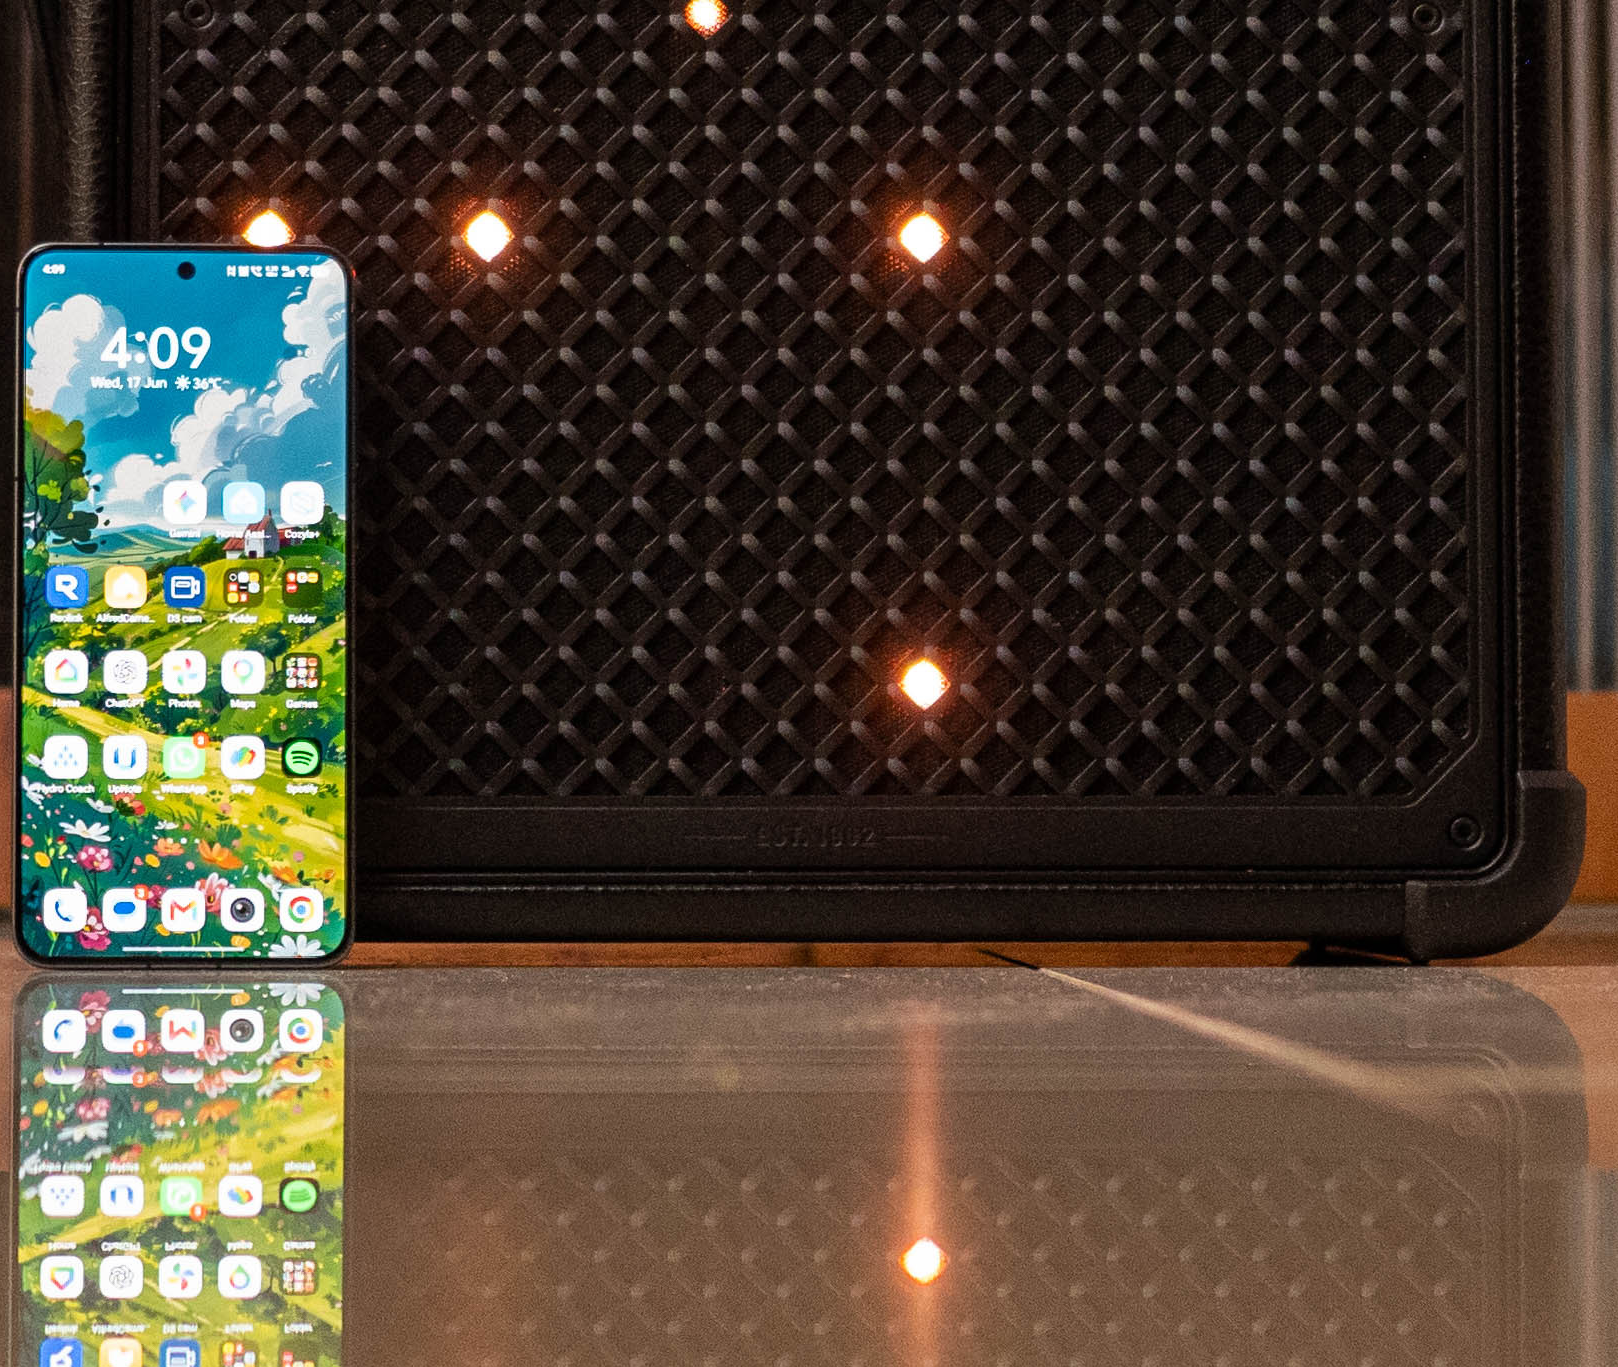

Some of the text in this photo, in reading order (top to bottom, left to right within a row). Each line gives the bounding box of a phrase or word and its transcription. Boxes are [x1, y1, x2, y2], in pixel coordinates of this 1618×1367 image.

[100, 326, 211, 370] 4:09
[90, 376, 124, 391] Wed,
[127, 376, 140, 389] 17
[143, 376, 168, 390] Jun
[229, 613, 258, 624] Folder
[288, 613, 317, 624] Folder
[52, 698, 81, 708] Home
[105, 698, 145, 708] ChatGPT
[168, 698, 201, 708] Photos
[230, 698, 257, 710] Maps
[285, 698, 318, 709] Games
[65, 784, 95, 794] Coach
[160, 784, 208, 795] WhatsApp
[286, 783, 319, 795] Spotify
